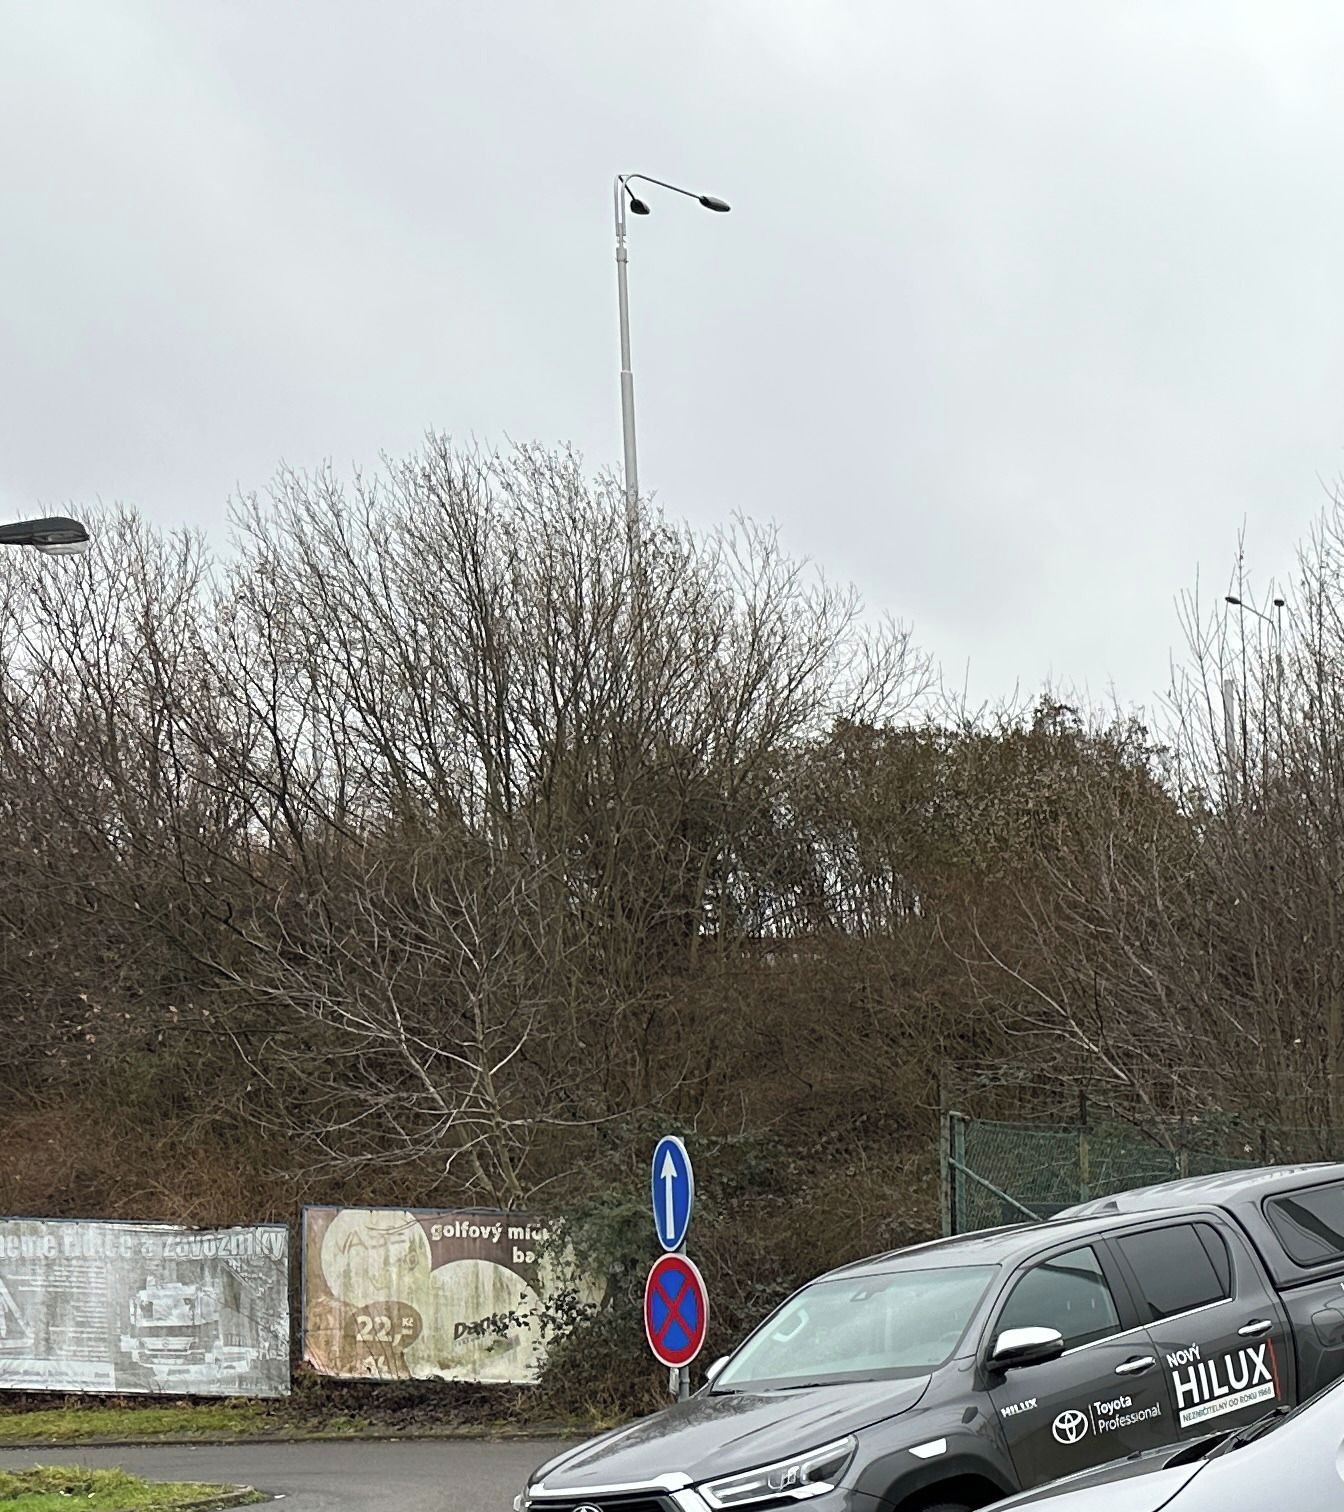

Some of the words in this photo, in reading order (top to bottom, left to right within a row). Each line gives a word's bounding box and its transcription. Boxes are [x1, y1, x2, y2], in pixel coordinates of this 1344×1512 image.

[430, 1221, 502, 1243] golfový
[1166, 1342, 1201, 1368] NOVÝ
[1172, 1343, 1272, 1408] HILUX
[1000, 1397, 1038, 1418] HILUX
[1094, 1395, 1133, 1416] Toyota
[1099, 1402, 1162, 1434] Professional
